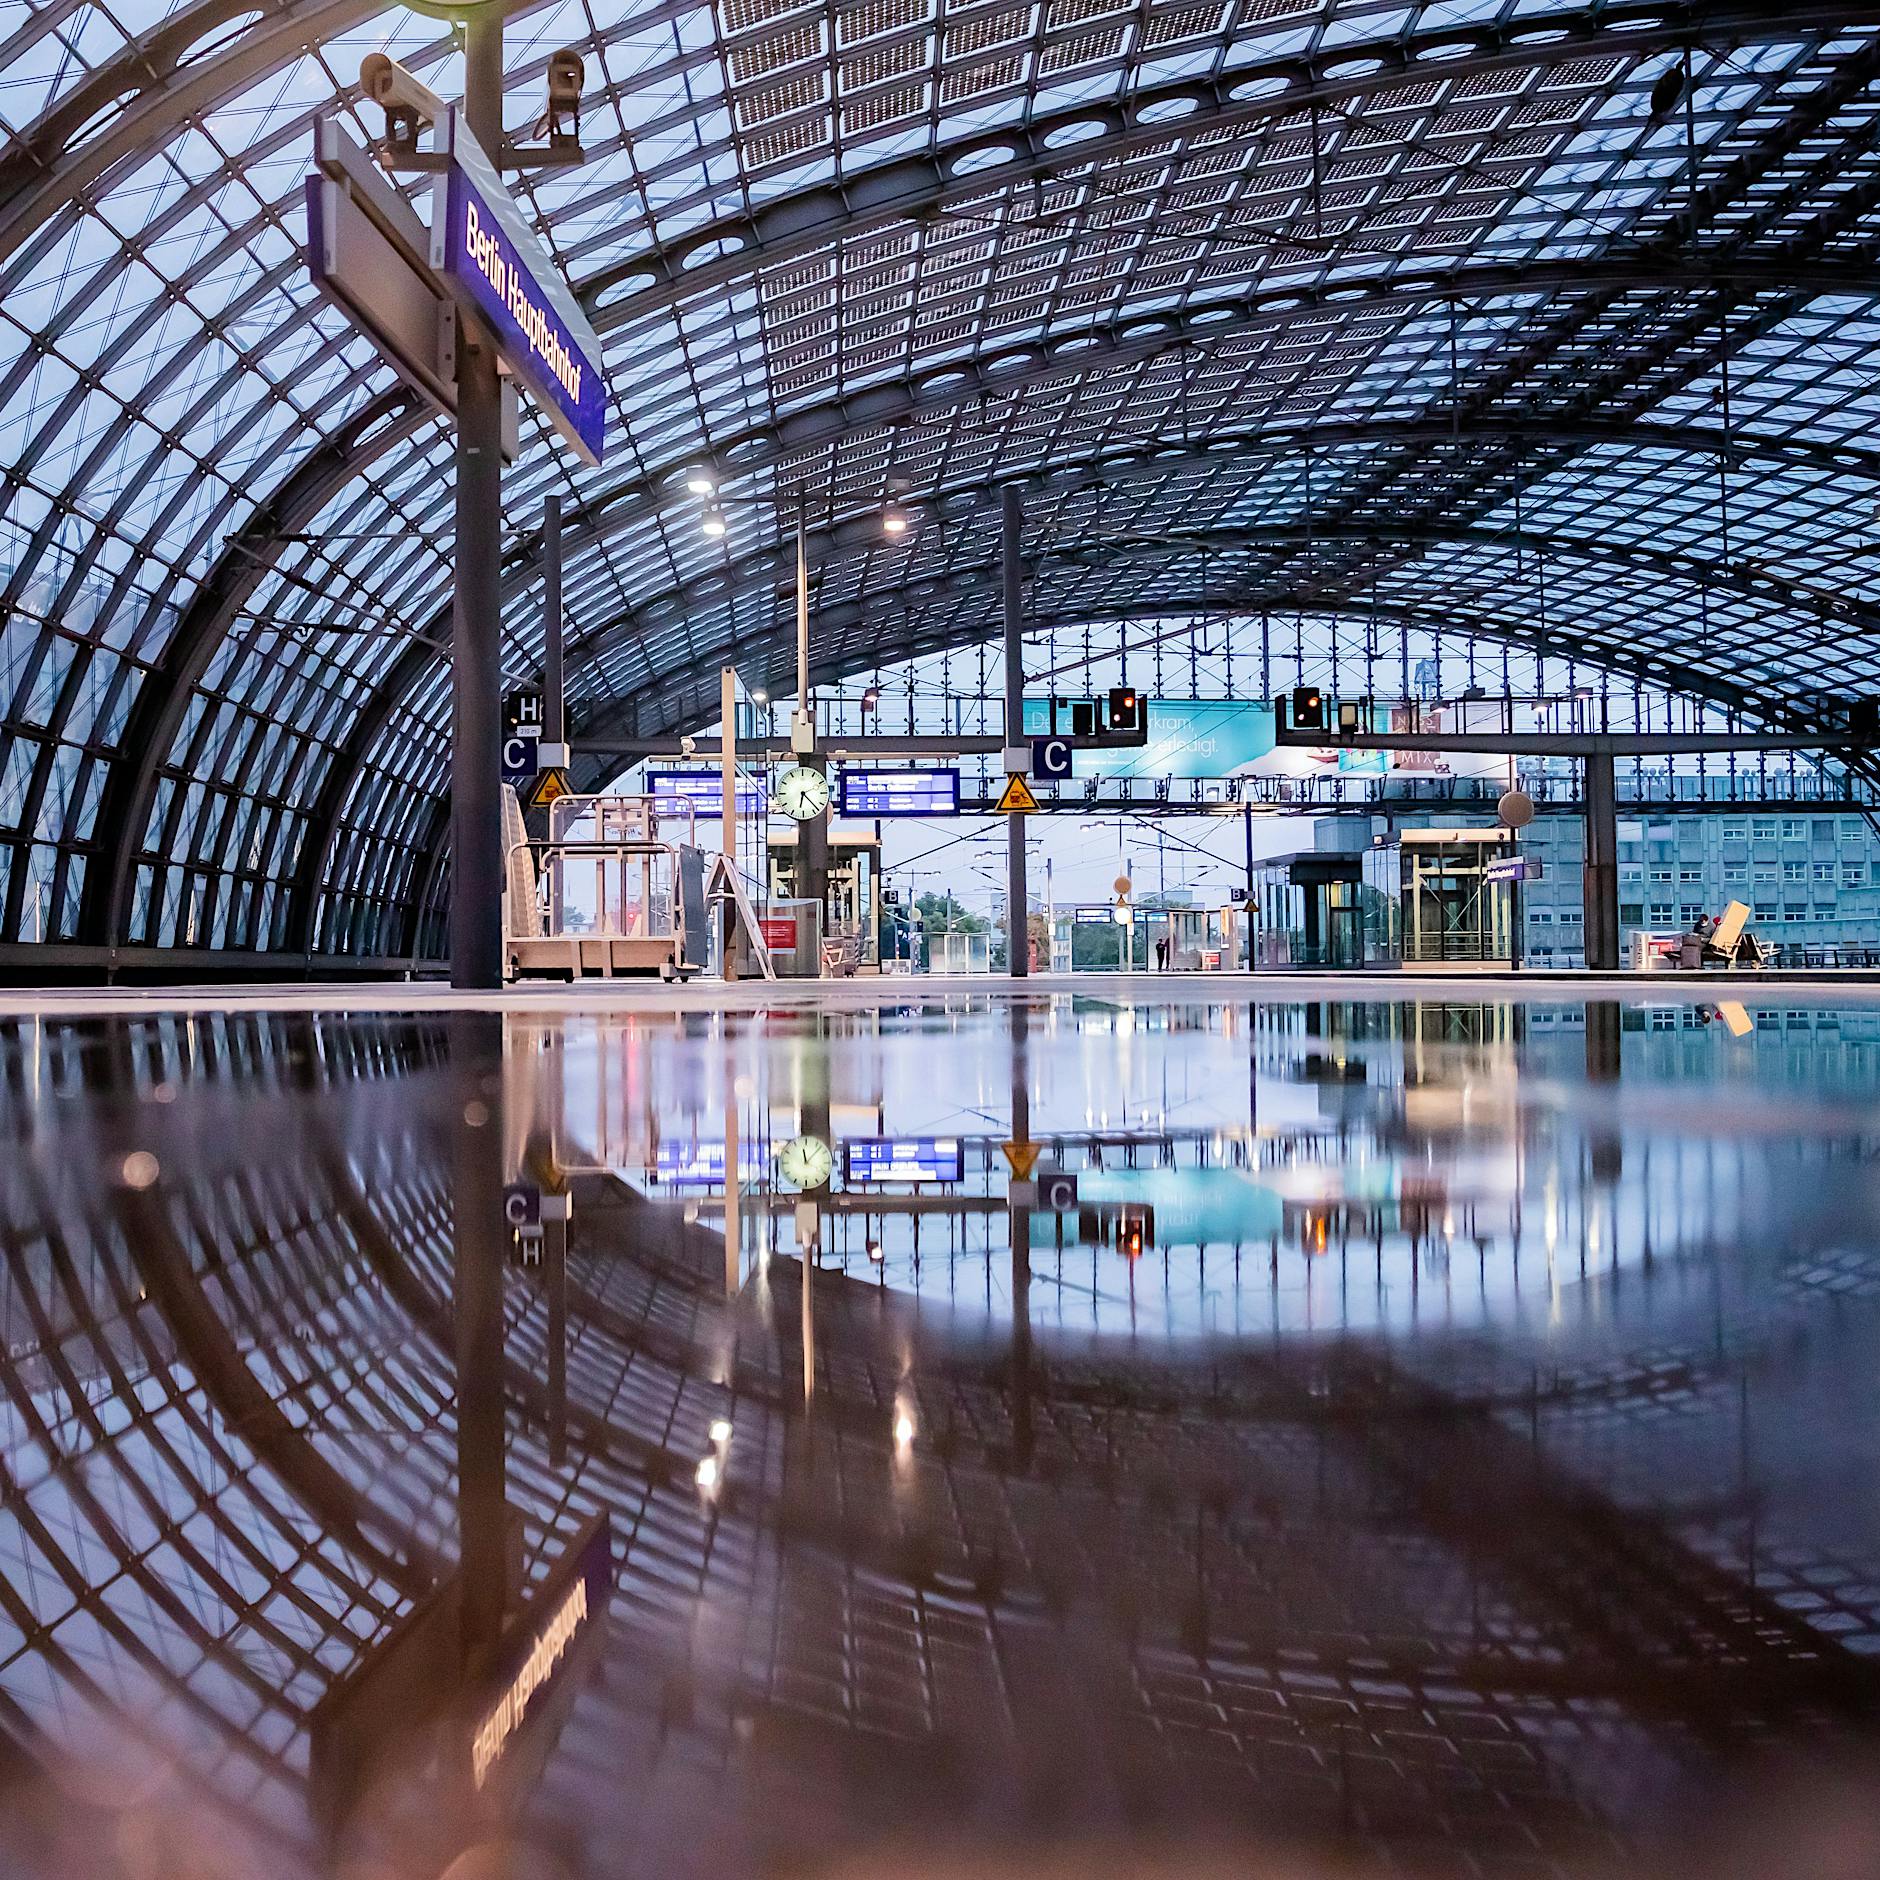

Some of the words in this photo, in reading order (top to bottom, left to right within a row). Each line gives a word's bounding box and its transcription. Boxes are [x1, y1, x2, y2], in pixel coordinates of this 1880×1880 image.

[466, 200, 506, 301] Berlin
[507, 263, 582, 405] Hauptbahnhof
[520, 697, 537, 721] H
[503, 738, 526, 769] C
[1044, 741, 1068, 772] C
[1401, 751, 1432, 764] MIX
[888, 891, 898, 902] B
[1232, 889, 1241, 900] B
